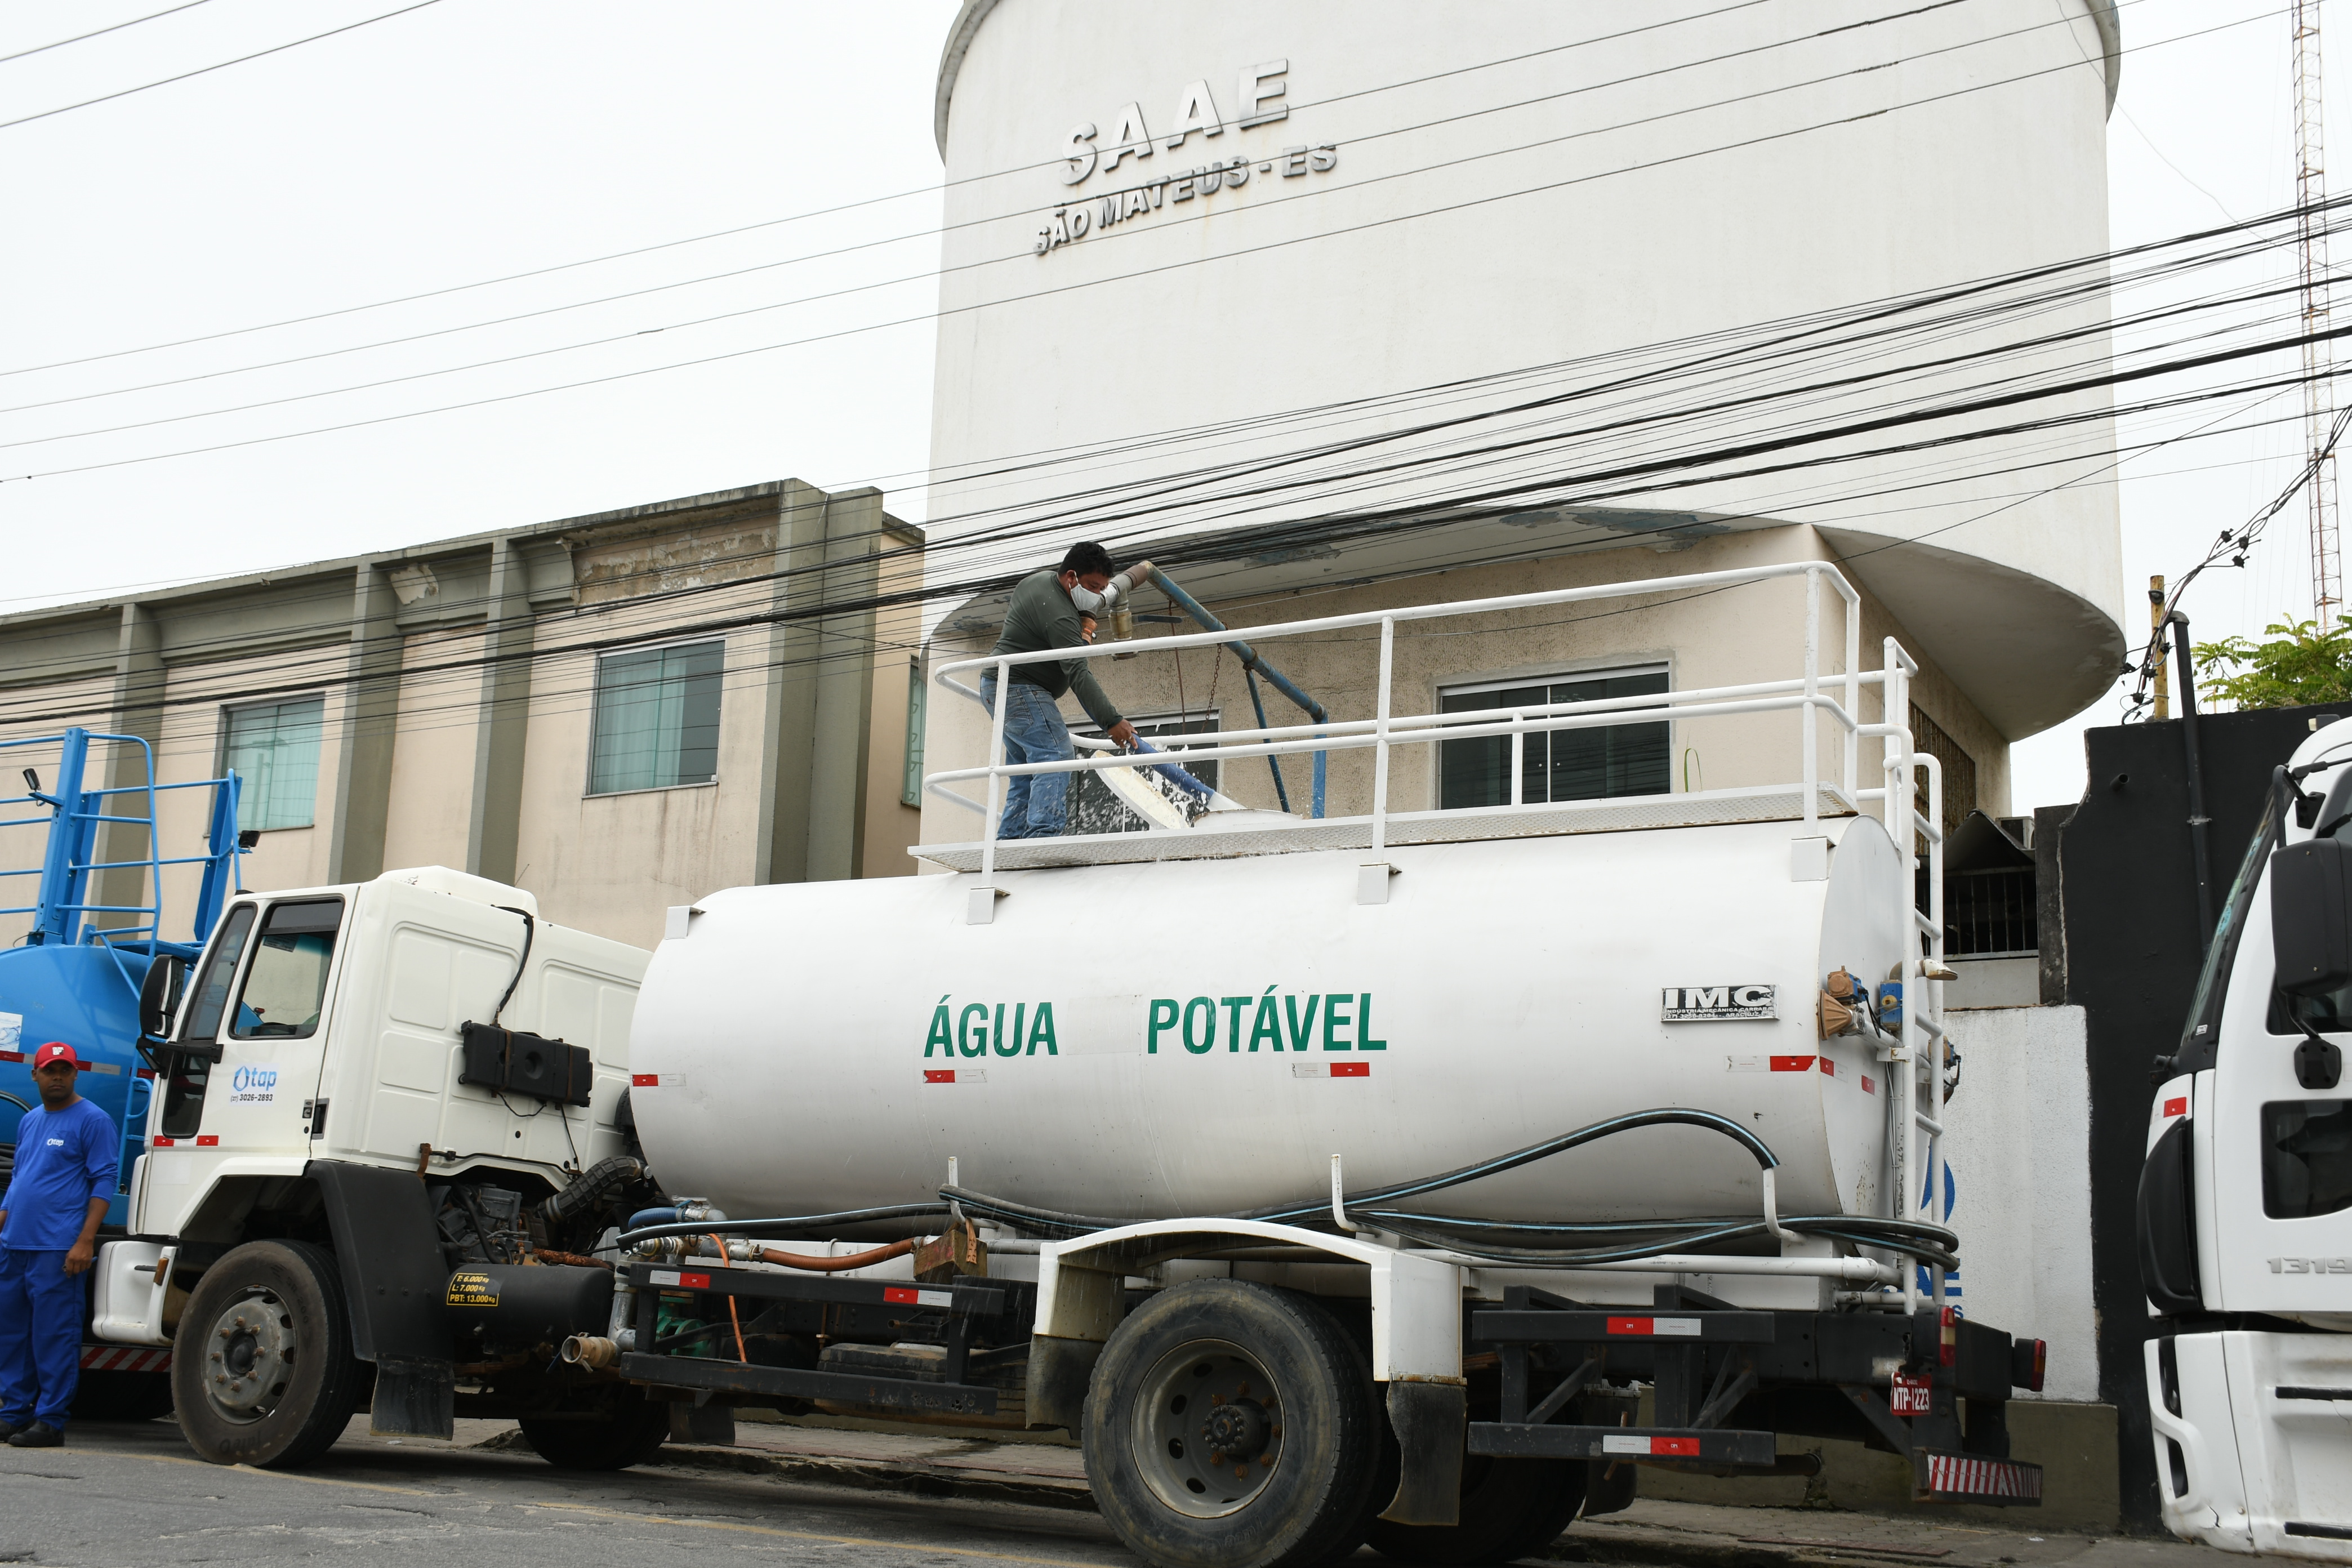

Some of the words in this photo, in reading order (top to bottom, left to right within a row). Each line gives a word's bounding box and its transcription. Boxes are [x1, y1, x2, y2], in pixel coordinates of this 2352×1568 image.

[1060, 58, 1289, 185] SAAE
[1033, 208, 1091, 256] SÃO
[1097, 155, 1250, 229] MATEUS
[924, 995, 1059, 1058] ÁGUA
[1147, 985, 1387, 1054] POTÁVEL
[1665, 986, 1772, 1009] IMC
